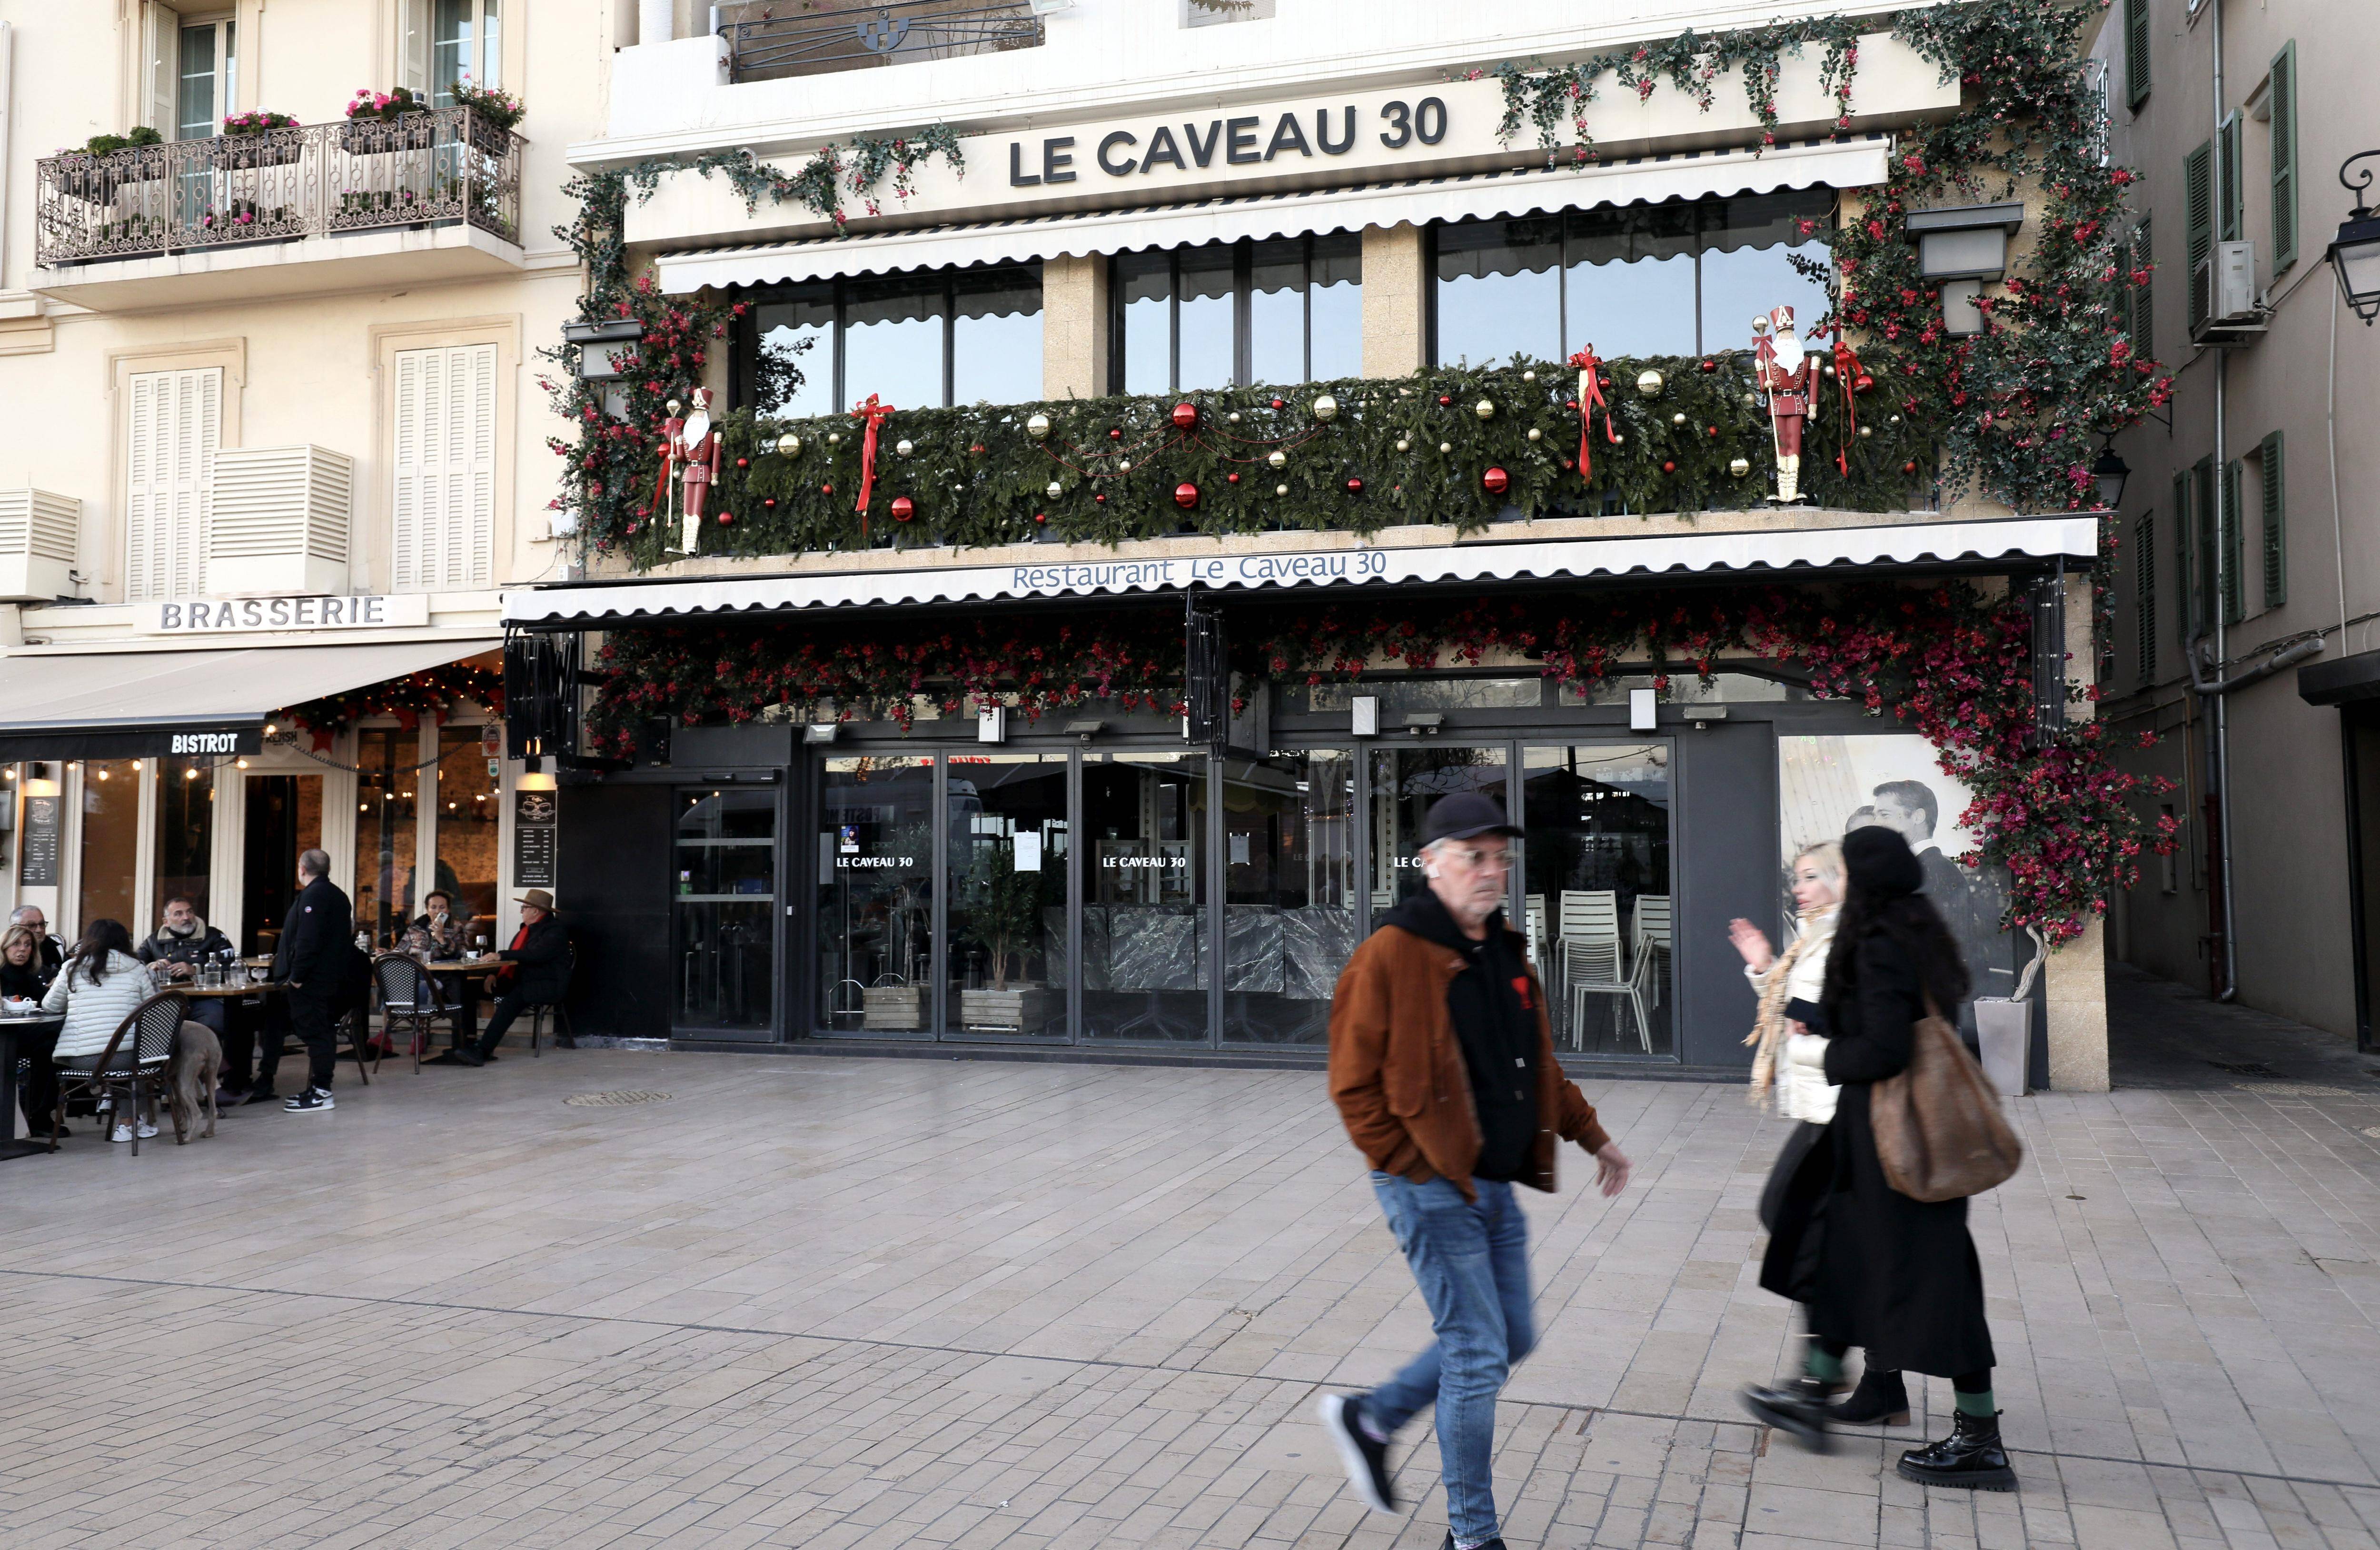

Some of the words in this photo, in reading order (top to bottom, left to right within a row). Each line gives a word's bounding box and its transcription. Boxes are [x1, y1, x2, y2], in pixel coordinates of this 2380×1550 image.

[1010, 137, 1077, 187] LE
[1097, 105, 1356, 176] CAVEAU
[1379, 97, 1448, 148] 30
[1014, 561, 1174, 589] Restaurant
[1192, 560, 1223, 579] Le
[1240, 556, 1346, 578] Caveau
[1357, 552, 1386, 574] 30
[162, 597, 383, 628] BRASSERIE
[171, 734, 238, 753] BISTROT
[837, 858, 849, 867] LE
[852, 857, 894, 867] CAVEAU
[899, 857, 913, 867] 30
[1103, 857, 1116, 867] LE
[1120, 857, 1166, 868] CAVEAU
[1170, 857, 1186, 867] 30
[1394, 857, 1408, 867] LE
